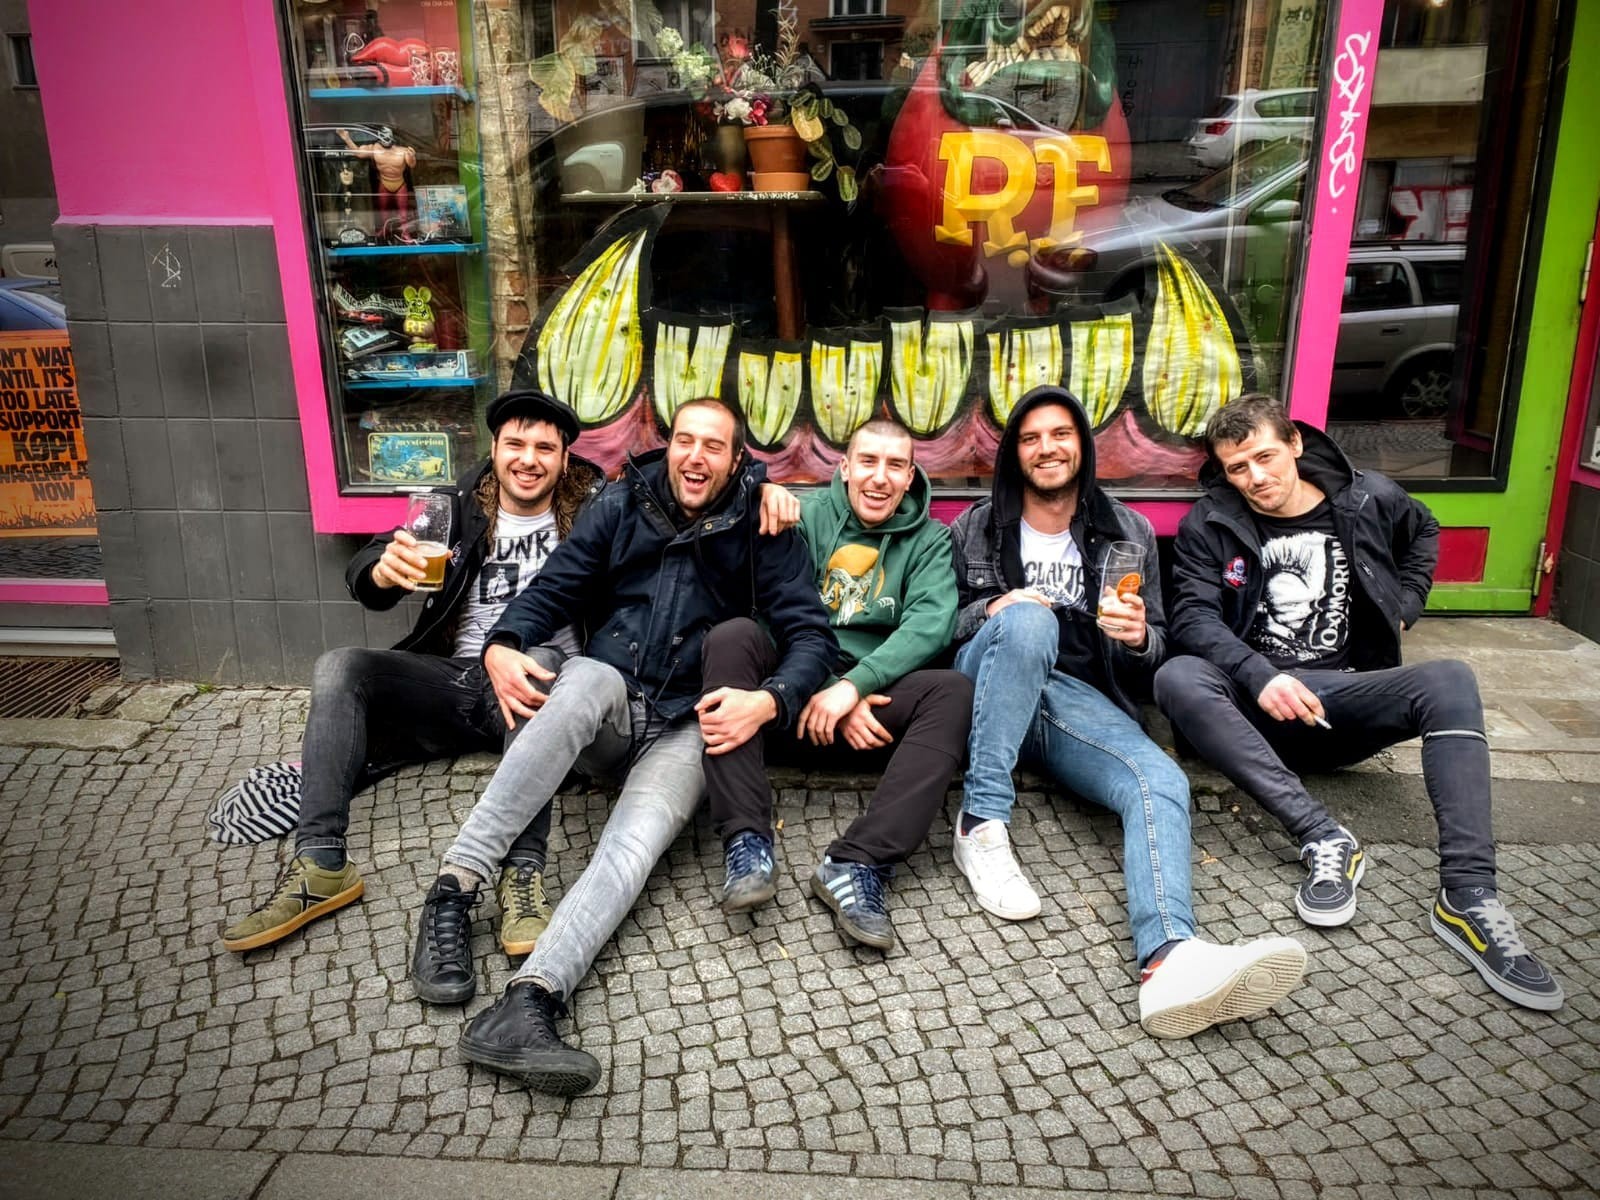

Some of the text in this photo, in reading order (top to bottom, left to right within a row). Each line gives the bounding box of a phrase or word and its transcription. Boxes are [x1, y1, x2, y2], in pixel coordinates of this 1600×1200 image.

[0, 347, 72, 368] N'T WAI
[0, 367, 75, 389] NTIL IT'S
[33, 390, 77, 409] LATE
[0, 410, 80, 430] SUPPORT
[31, 482, 75, 501] NOW
[497, 530, 551, 562] UNK
[1025, 561, 1084, 598] CLAYTO
